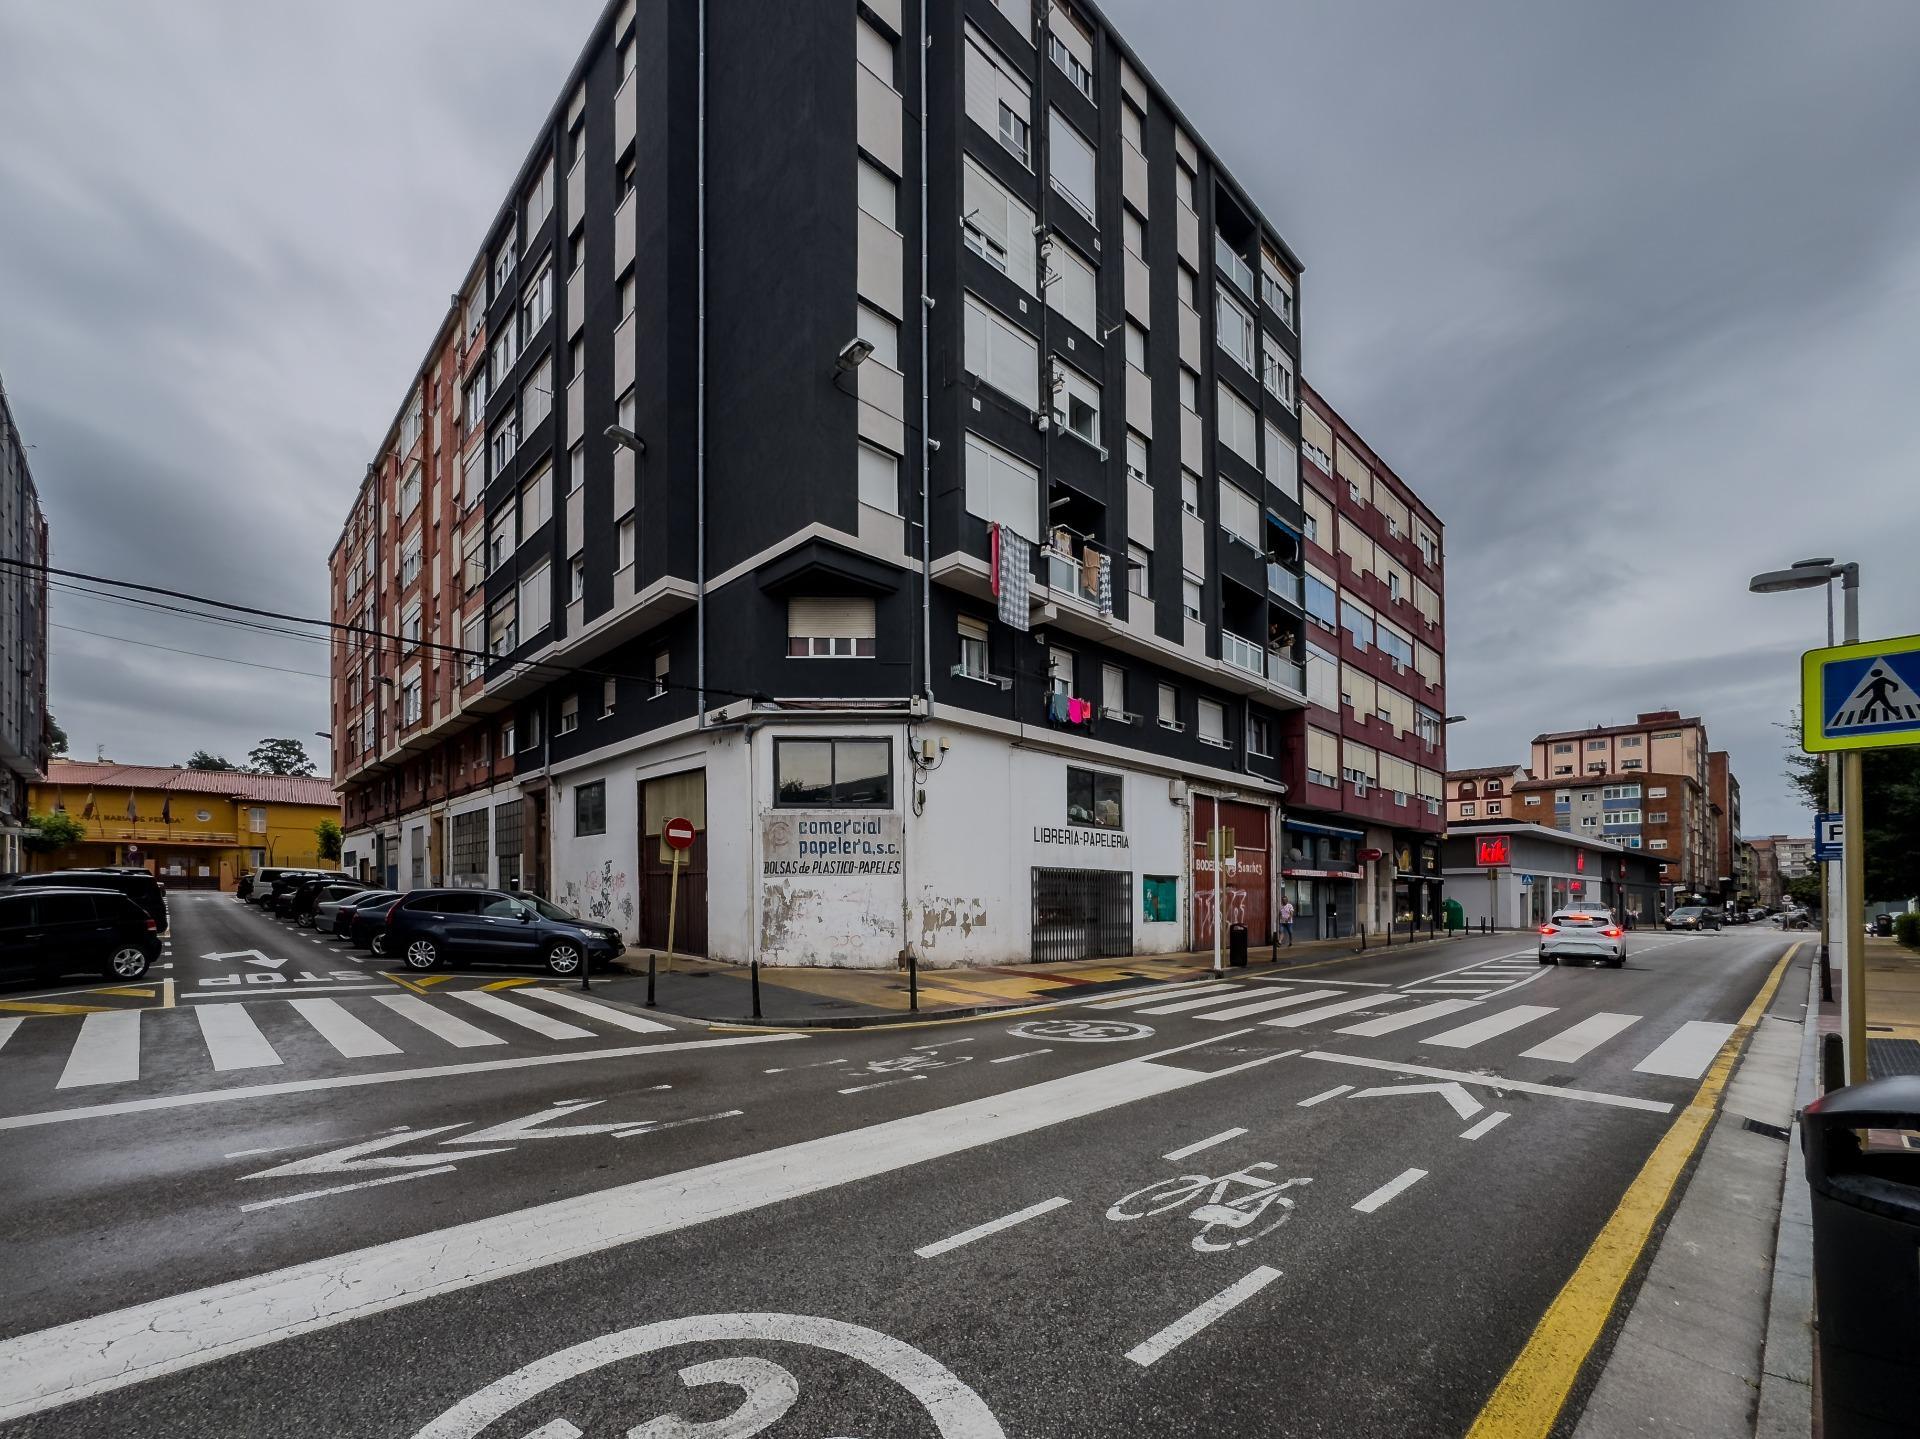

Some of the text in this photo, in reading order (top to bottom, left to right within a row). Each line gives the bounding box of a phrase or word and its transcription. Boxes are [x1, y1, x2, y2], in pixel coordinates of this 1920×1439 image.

[798, 816, 882, 835] comercial
[1033, 826, 1130, 849] LIBRERIA-PAPELERIA
[764, 860, 797, 875] BOLSAS
[798, 861, 810, 875] de
[198, 969, 376, 986] STOP
